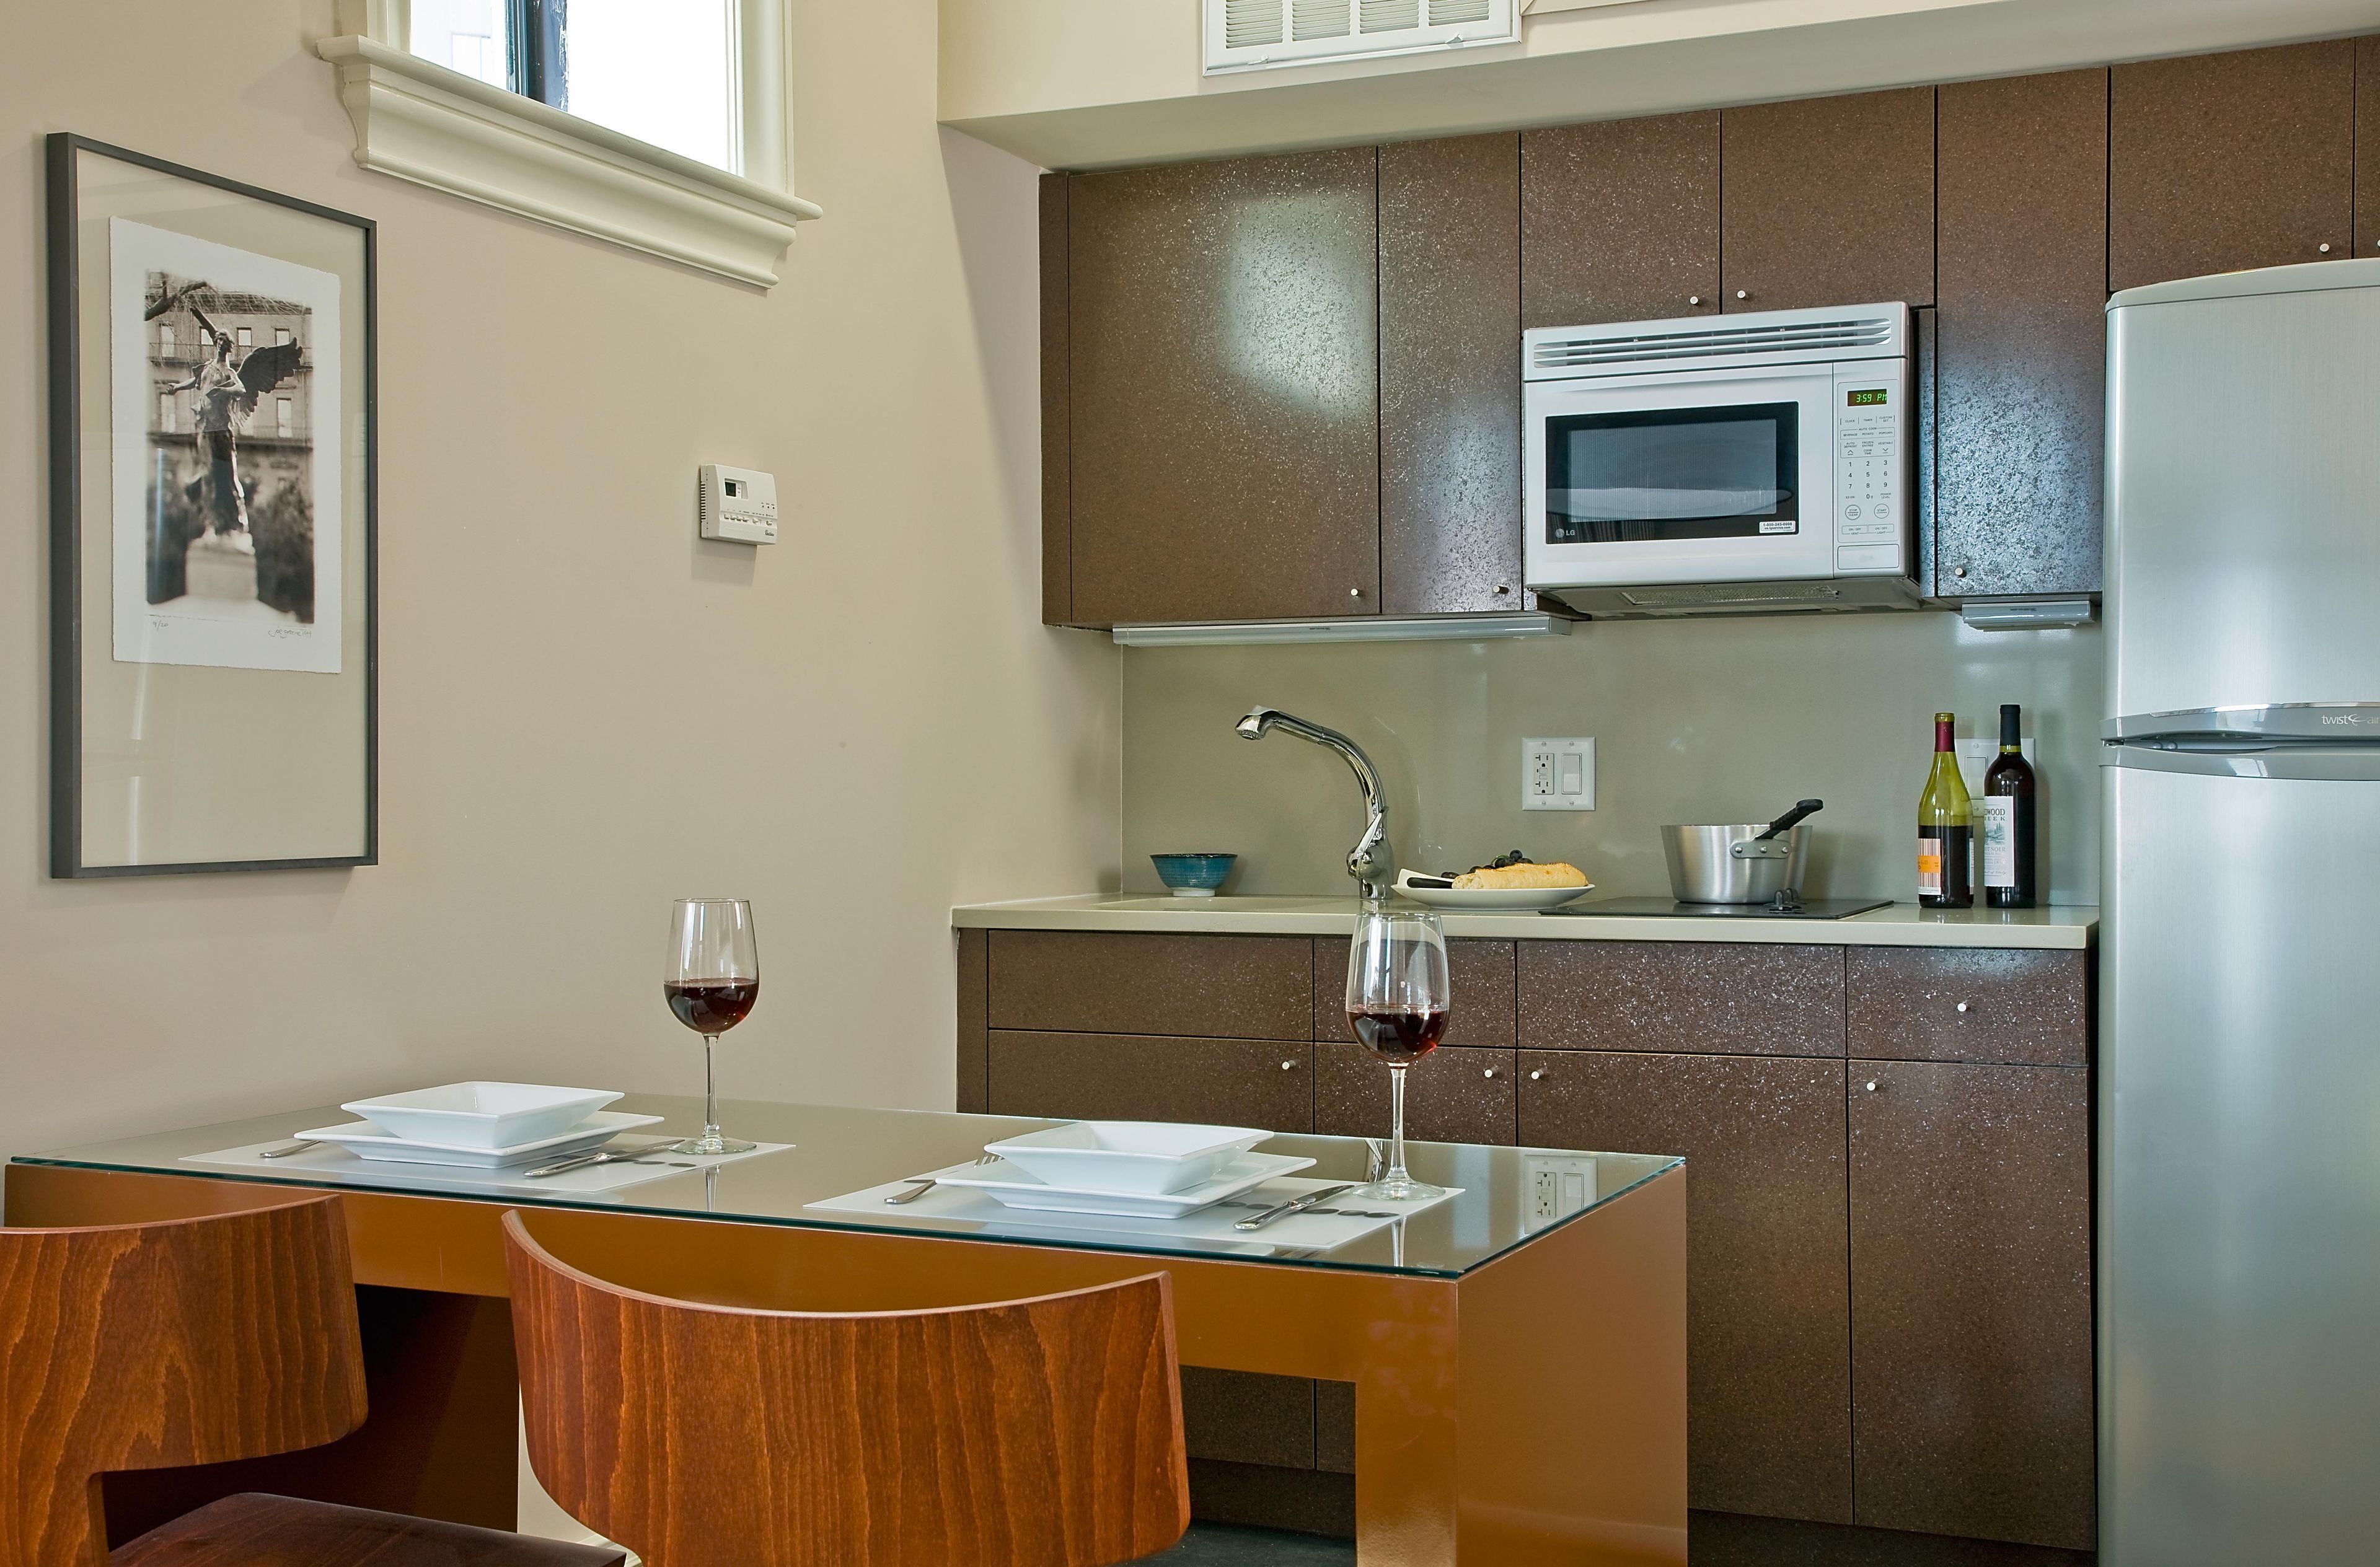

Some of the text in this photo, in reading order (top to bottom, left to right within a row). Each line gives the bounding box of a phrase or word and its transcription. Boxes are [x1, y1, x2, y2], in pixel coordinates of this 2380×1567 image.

[1856, 394, 1872, 402] 3:59
[2321, 715, 2379, 724] twist air
